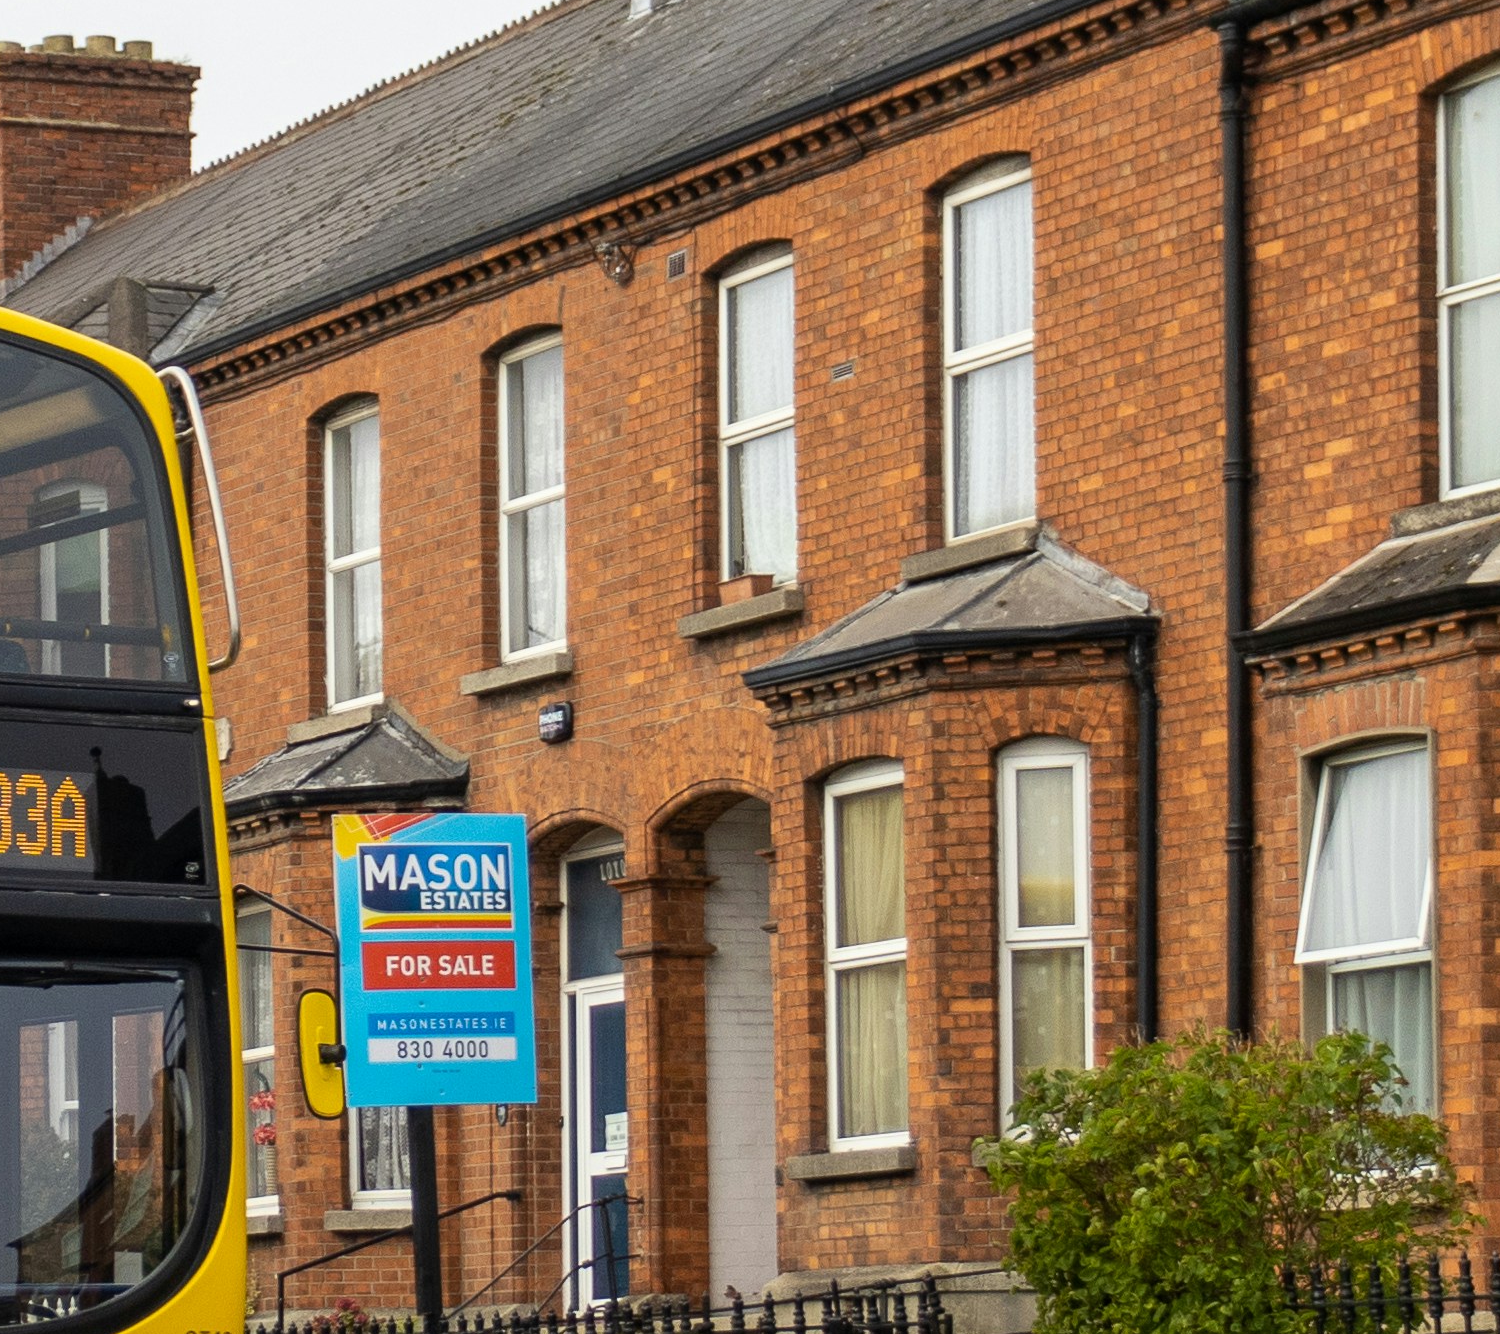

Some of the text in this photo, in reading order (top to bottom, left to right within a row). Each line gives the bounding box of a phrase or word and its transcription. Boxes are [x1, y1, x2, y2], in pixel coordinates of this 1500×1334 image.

[363, 853, 506, 891] MASON
[420, 891, 507, 910] ESTATES
[385, 954, 495, 976] FOR SALE
[397, 1039, 489, 1059] 830 4000
